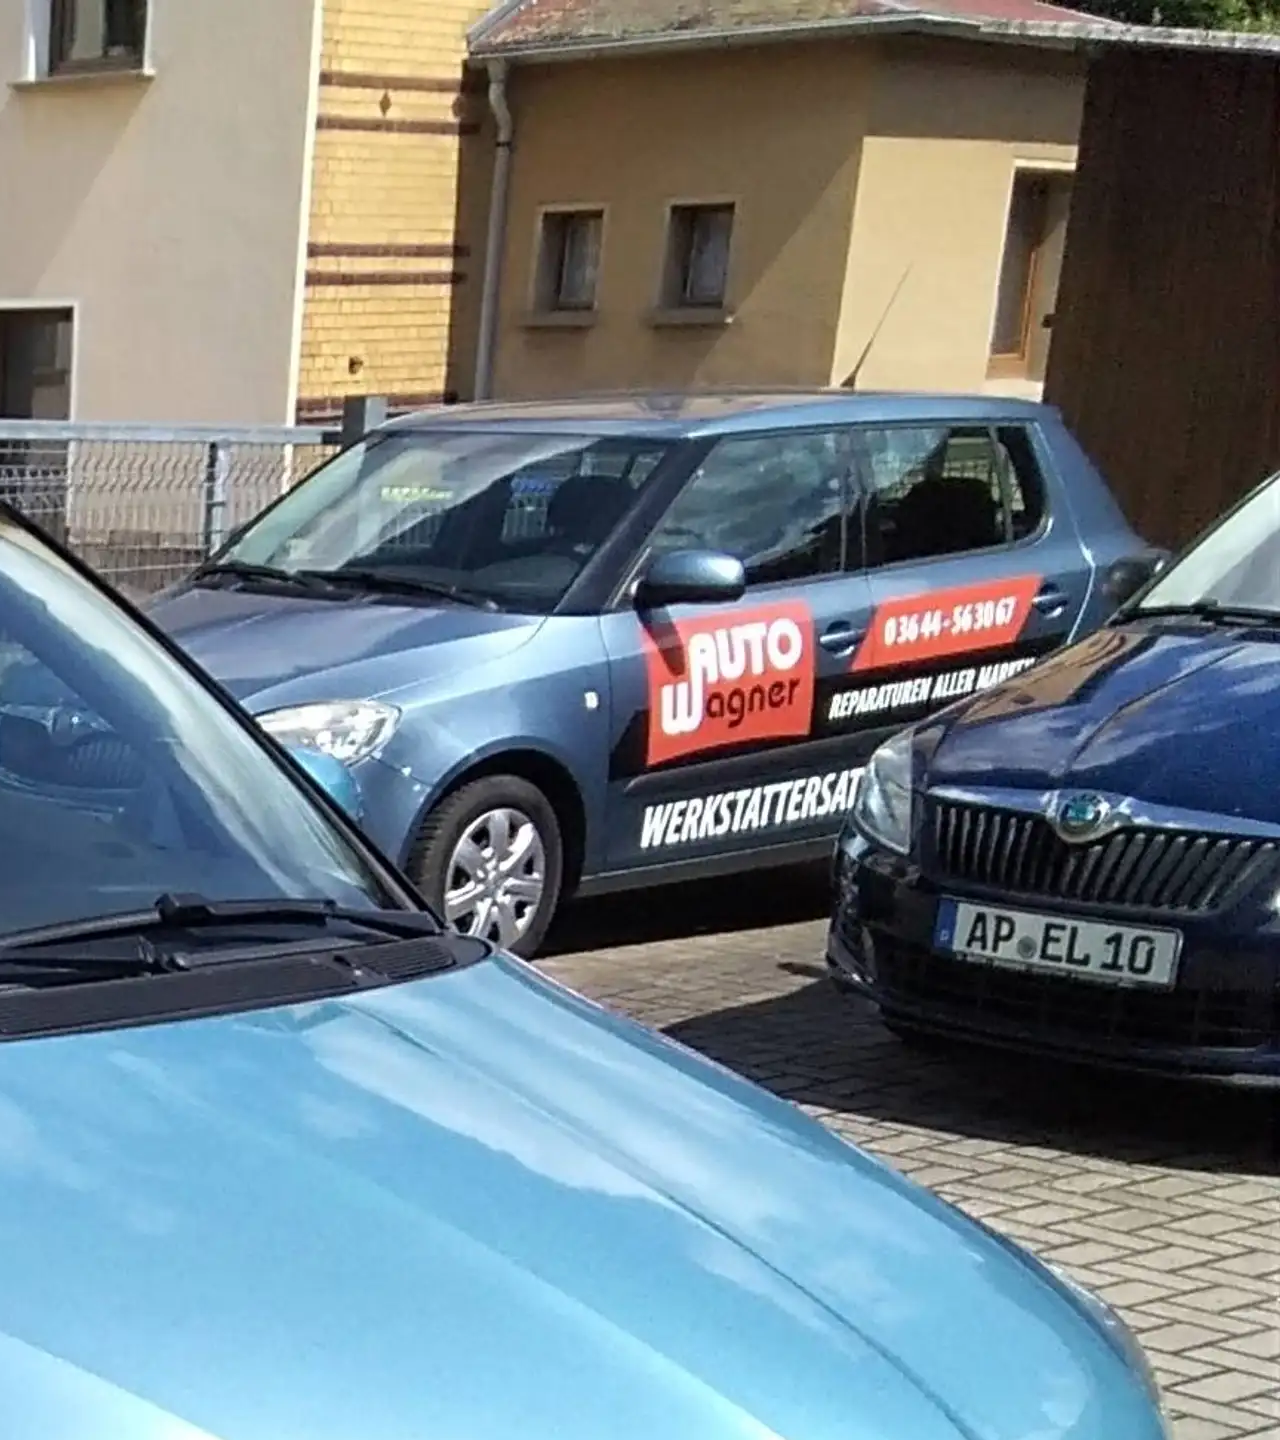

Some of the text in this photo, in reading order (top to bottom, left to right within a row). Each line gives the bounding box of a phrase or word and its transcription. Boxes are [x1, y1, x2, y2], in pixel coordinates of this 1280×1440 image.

[688, 617, 804, 685] AUTO
[883, 595, 1018, 647] 03644-563067
[660, 676, 801, 736] Wagner
[828, 676, 934, 721] REPARATUREN
[931, 667, 977, 700] ALLER
[965, 911, 1017, 954] AP
[1039, 922, 1091, 967] EL
[1099, 932, 1157, 976] 10
